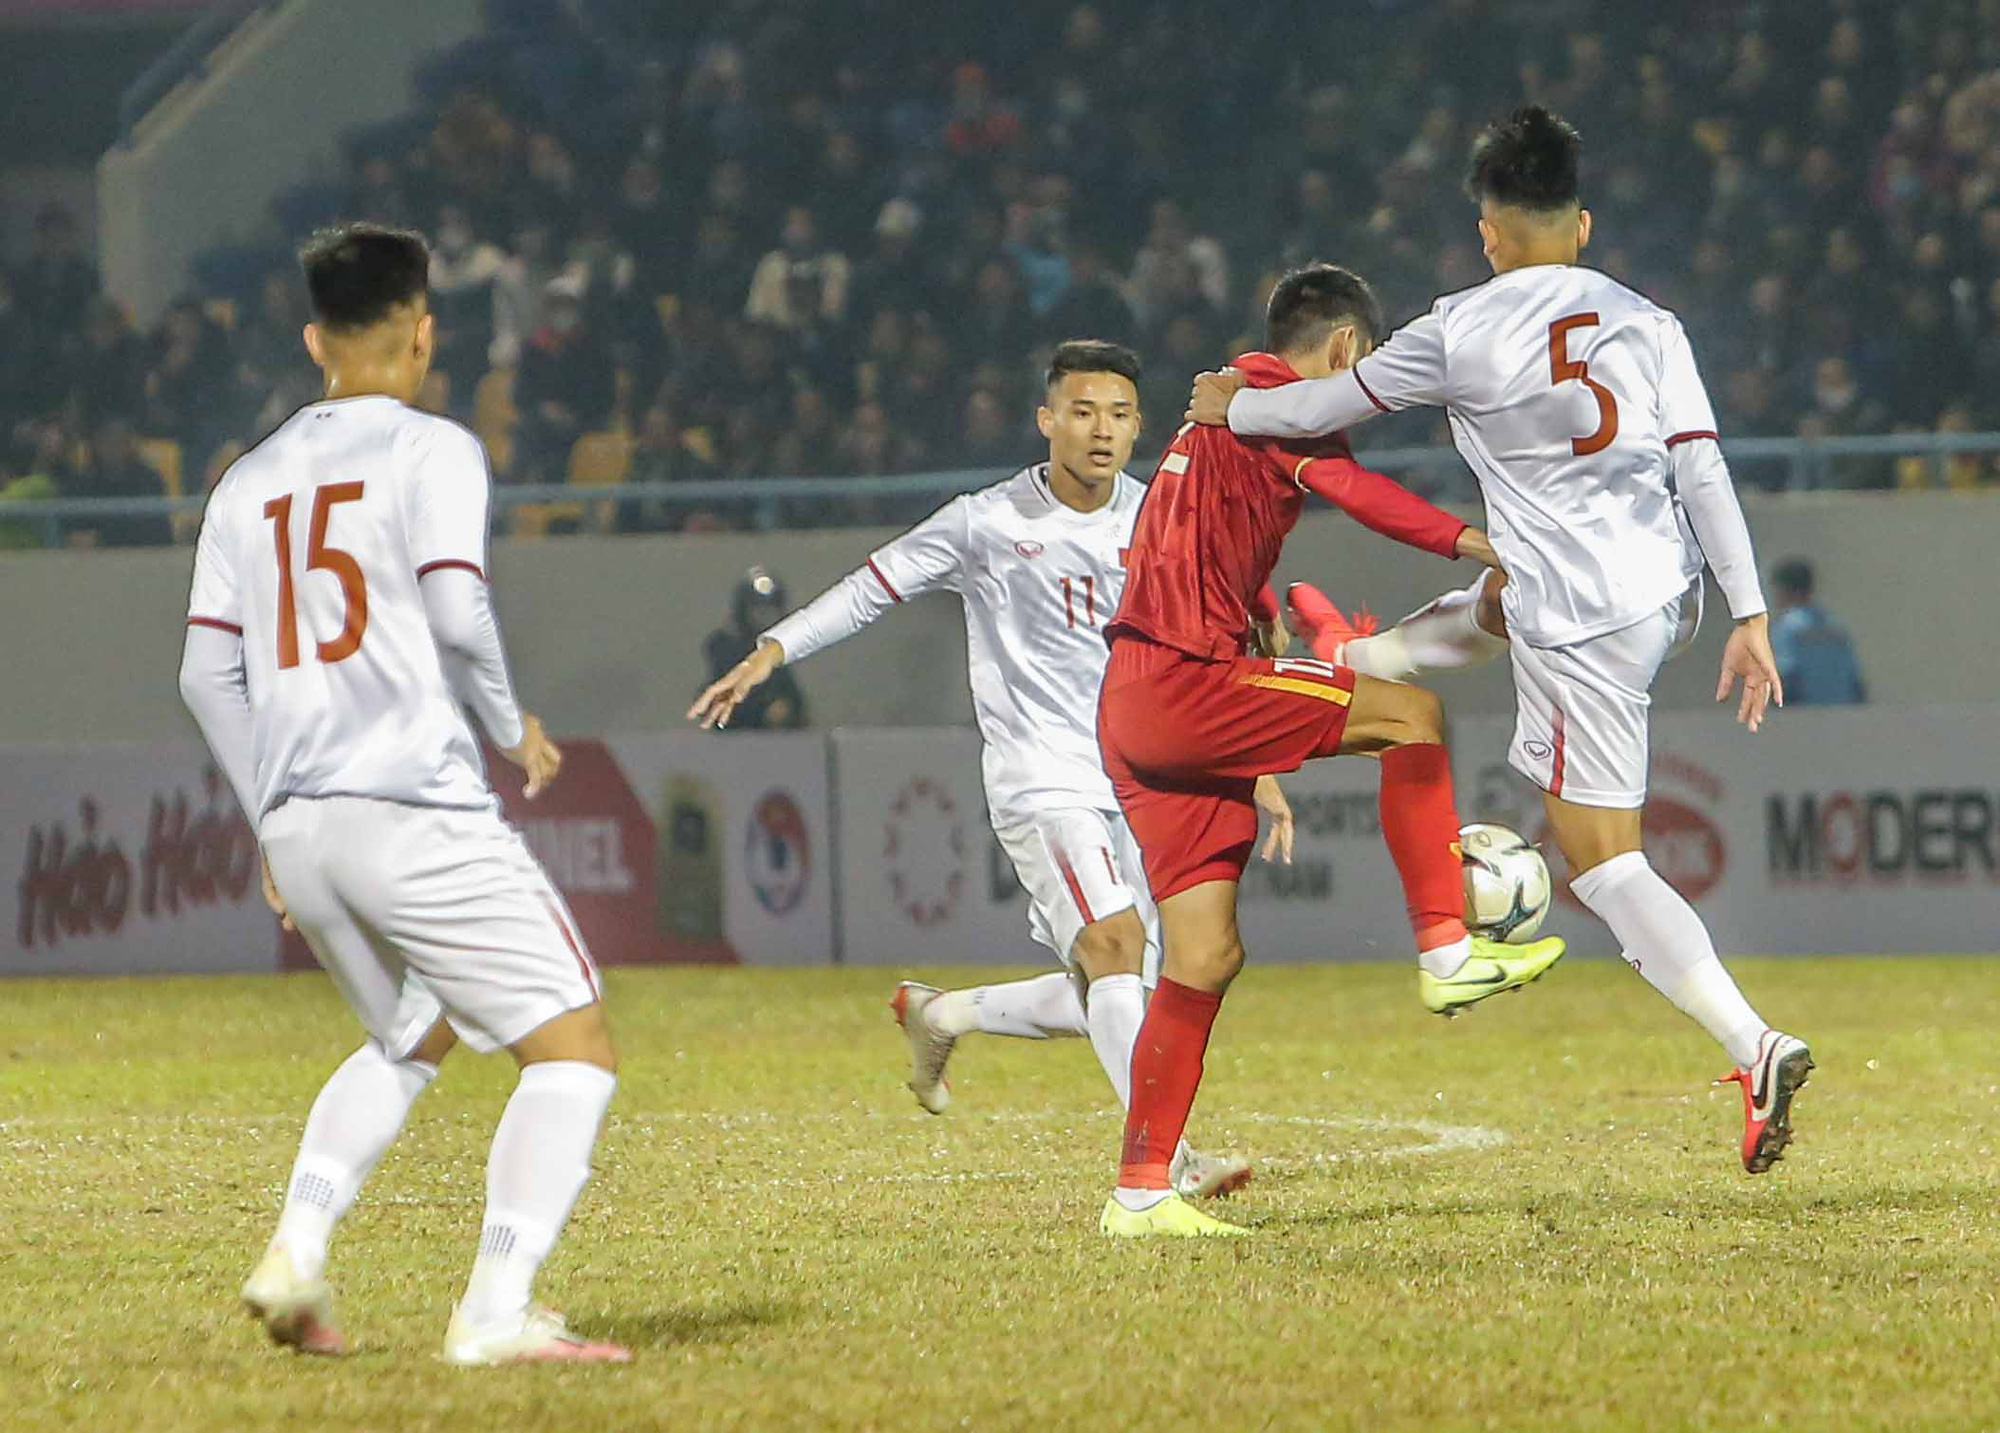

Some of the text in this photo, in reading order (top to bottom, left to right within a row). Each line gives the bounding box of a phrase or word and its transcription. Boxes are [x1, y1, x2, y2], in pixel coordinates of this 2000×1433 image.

[1548, 312, 1618, 456] 5
[263, 480, 368, 670] 15
[1059, 575, 1096, 629] 11
